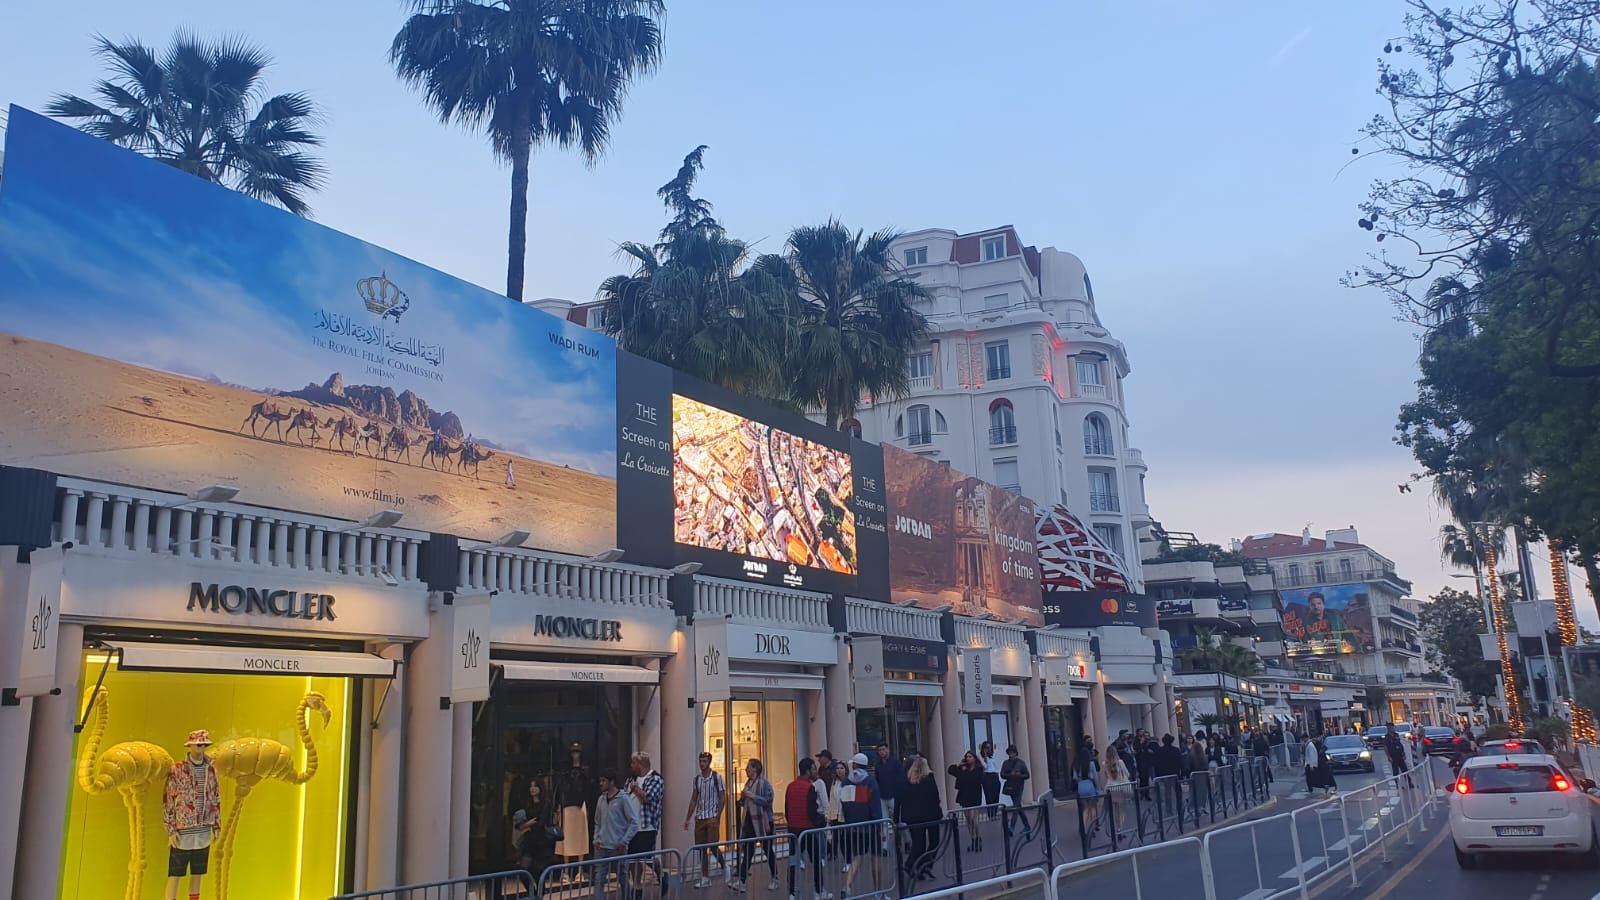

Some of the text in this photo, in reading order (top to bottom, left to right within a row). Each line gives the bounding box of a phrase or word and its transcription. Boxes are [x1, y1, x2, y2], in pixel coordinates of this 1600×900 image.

[548, 331, 600, 360] WADI RUM
[328, 340, 361, 358] ROYAL
[362, 349, 385, 366] FILM
[387, 357, 444, 382] COMMISSION
[636, 402, 657, 421] THE
[622, 426, 671, 452] Screen on
[620, 451, 670, 477] La Croisette
[343, 484, 405, 506] www.film.jo
[862, 476, 876, 490] THE
[855, 495, 885, 513] Screen on
[994, 525, 1033, 554] kingdom
[1002, 556, 1034, 580] of time
[186, 581, 338, 622] MONCLER
[533, 614, 624, 642] MONCLER
[755, 632, 791, 656] DIOR
[243, 657, 300, 671] MONCLER
[571, 671, 605, 681] MONCLER
